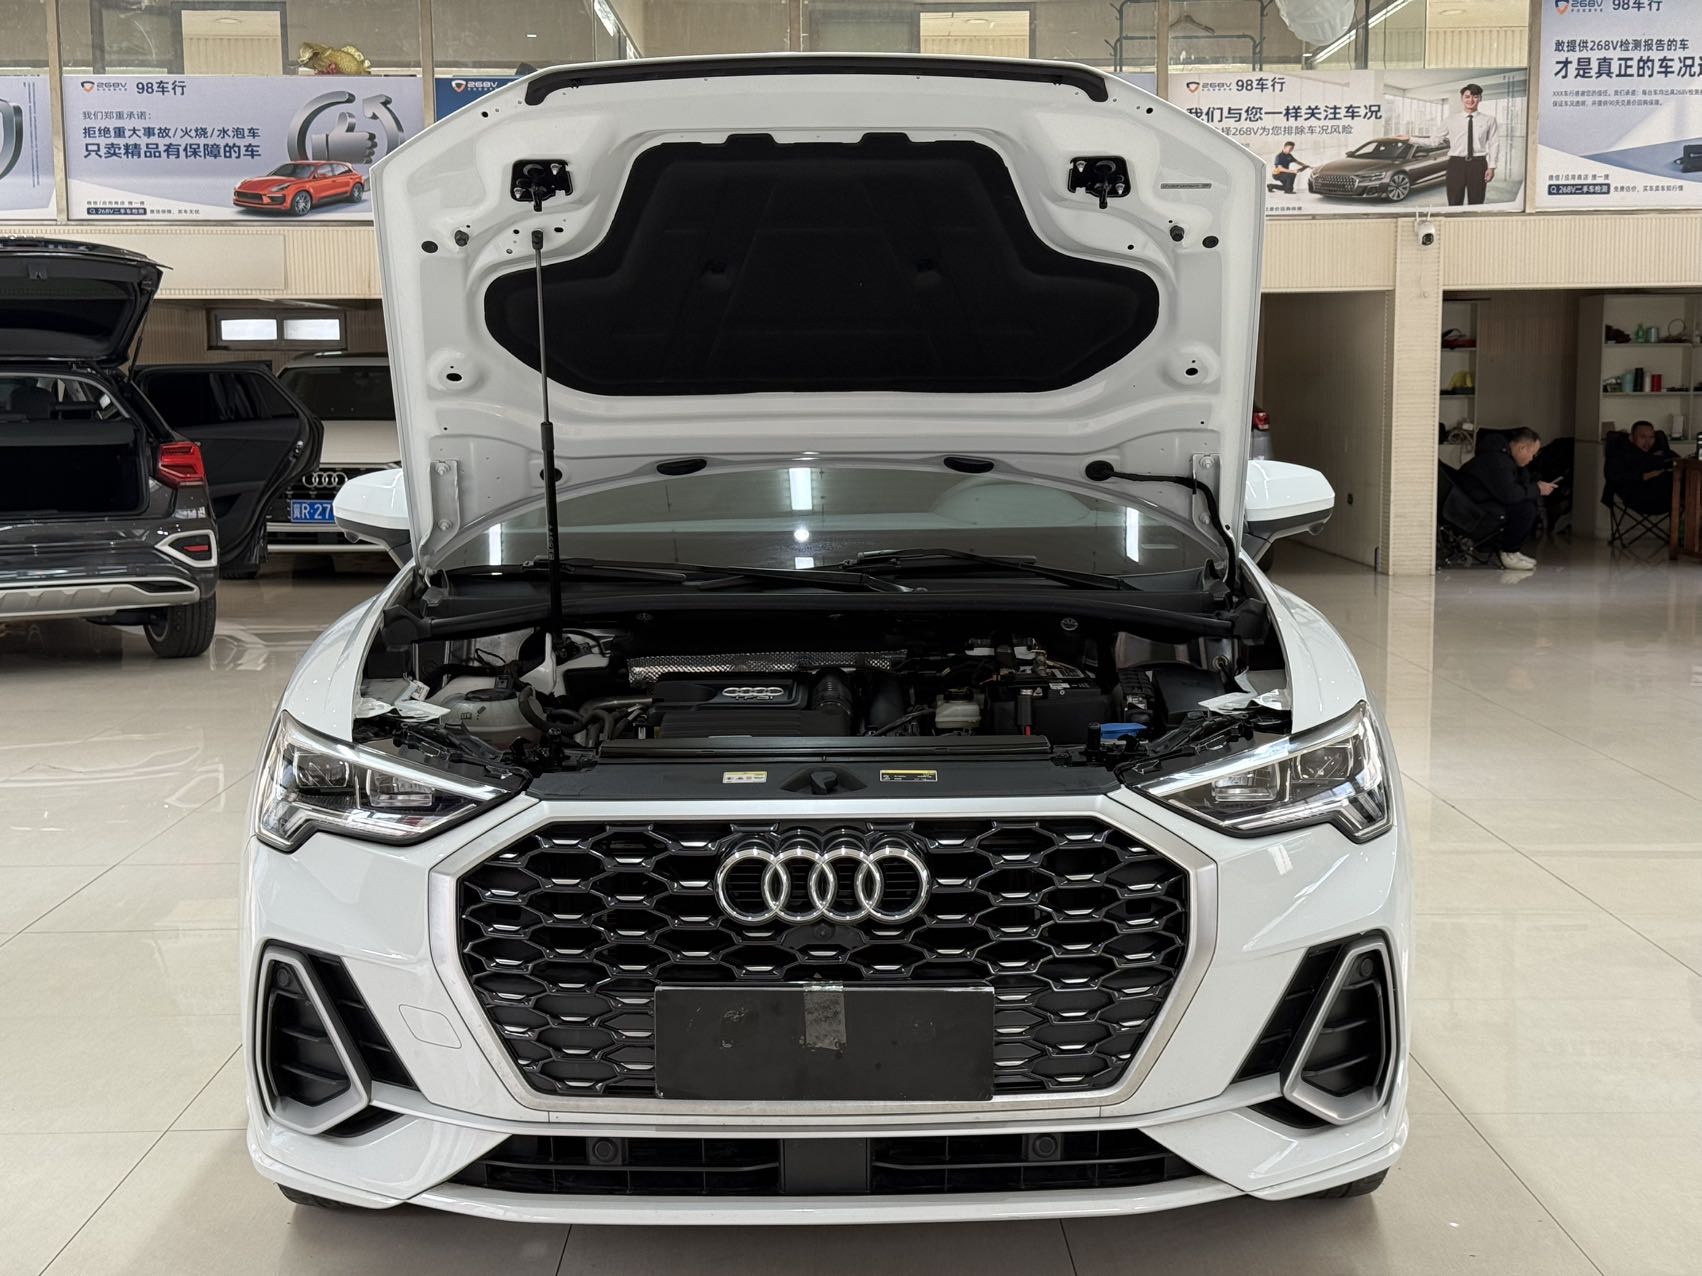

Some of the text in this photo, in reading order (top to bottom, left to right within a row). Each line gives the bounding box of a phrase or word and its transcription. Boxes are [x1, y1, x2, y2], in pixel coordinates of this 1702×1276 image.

[1612, 0, 1663, 12] 98车行
[1554, 38, 1690, 53] 敢提供268V检测报告的车
[136, 80, 187, 96] 98车行
[1235, 77, 1286, 93] 98车行
[1186, 104, 1383, 123] 我们与您一样关注车况
[82, 126, 261, 140] 拒绝重大事故/火烧/水泡车
[1216, 125, 1353, 138] 择268V为您排除车况风险
[83, 142, 262, 160] 只卖精品有保障的车
